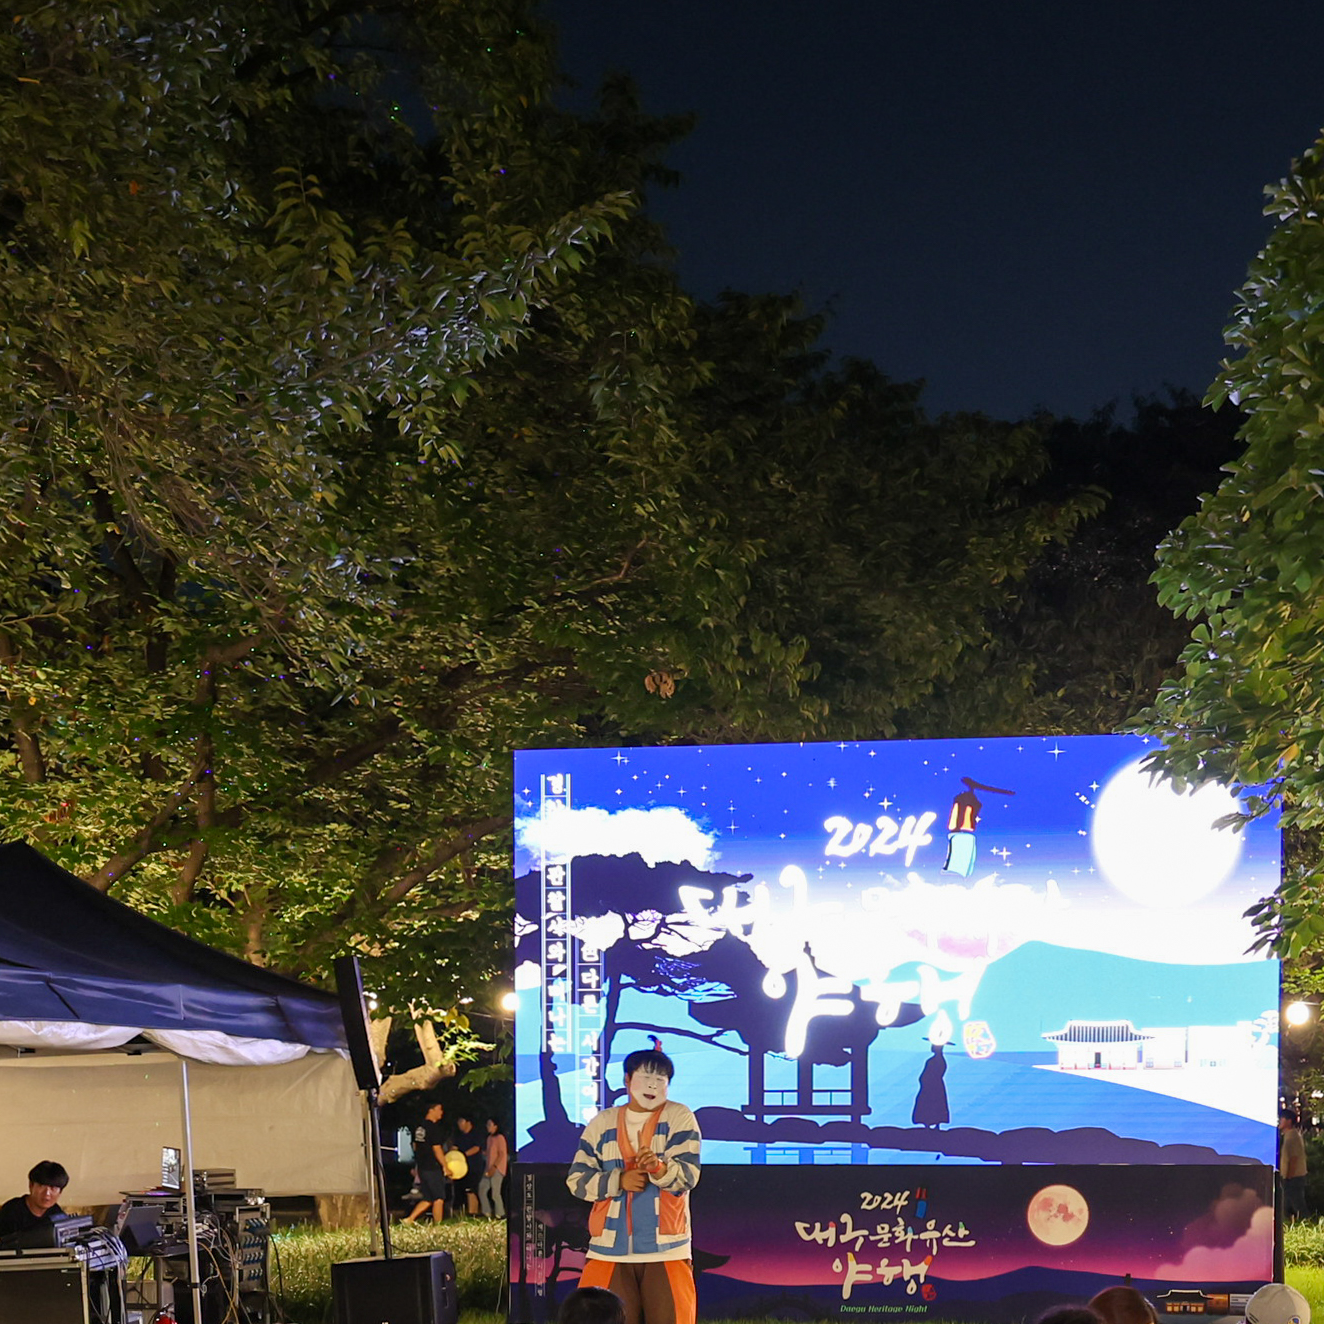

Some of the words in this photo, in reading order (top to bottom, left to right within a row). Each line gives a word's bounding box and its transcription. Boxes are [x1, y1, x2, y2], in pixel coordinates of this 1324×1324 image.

[824, 811, 937, 867] 2024
[860, 1190, 910, 1215] 2024
[832, 1252, 933, 1300] 야행
[840, 1304, 867, 1313] Daegu
[868, 1304, 903, 1314] Heritage
[905, 1304, 928, 1313] Night
